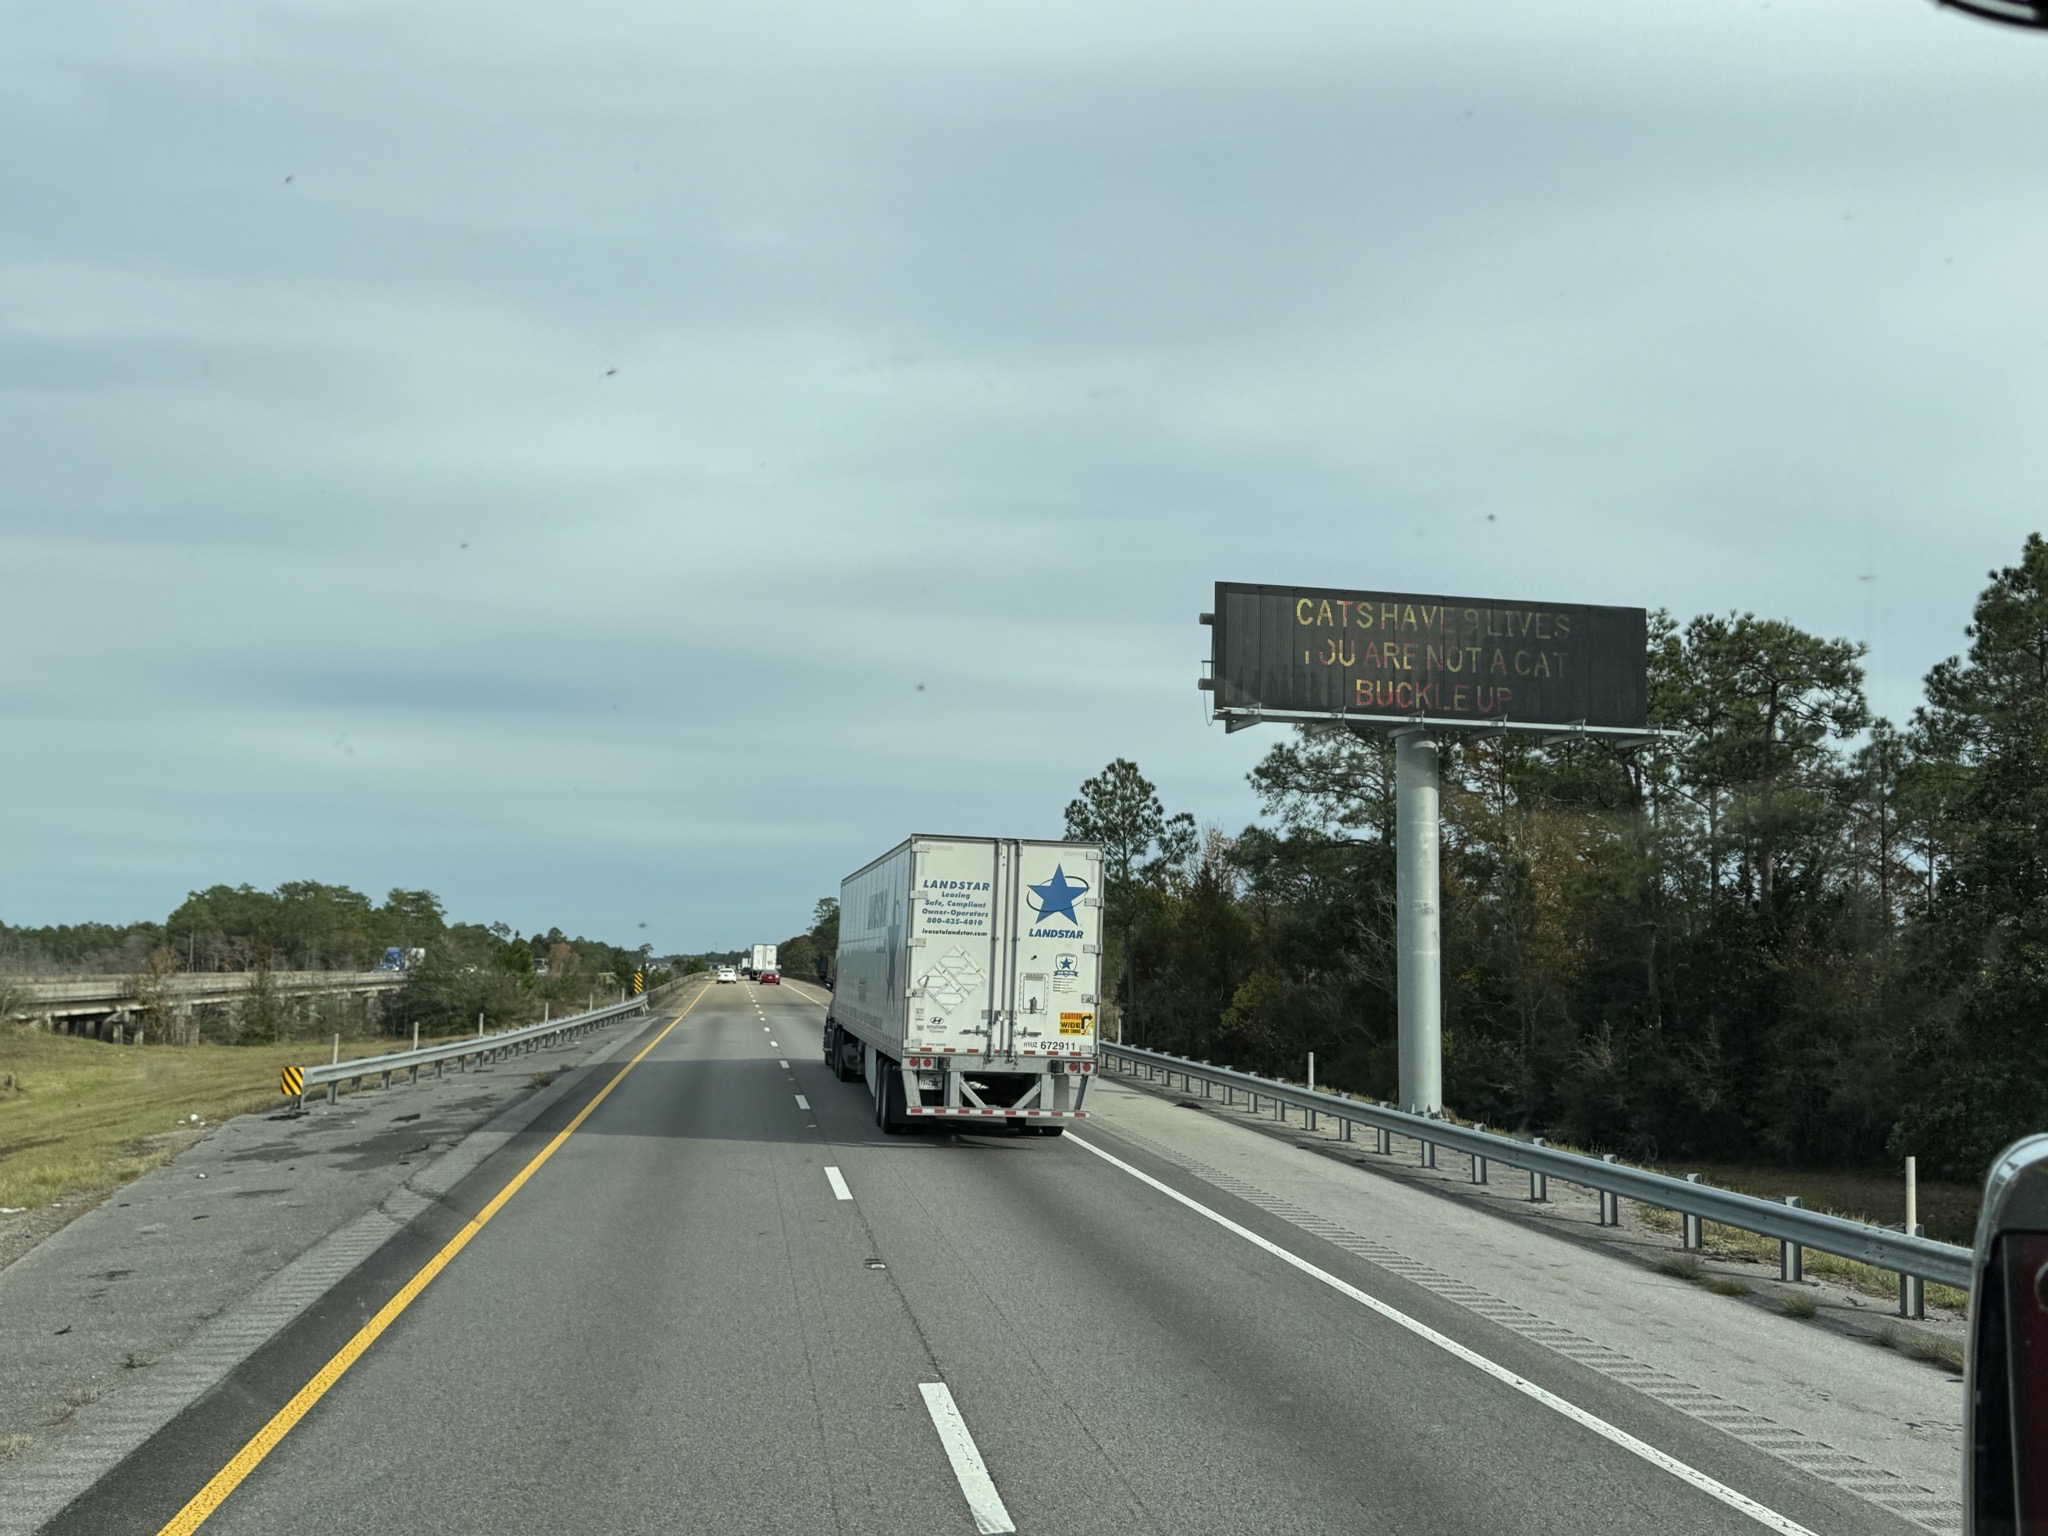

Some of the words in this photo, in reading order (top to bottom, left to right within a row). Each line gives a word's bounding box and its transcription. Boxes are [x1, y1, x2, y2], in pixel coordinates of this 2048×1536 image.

[1296, 598, 1374, 629] CATS
[1380, 603, 1455, 633] HAVE
[1463, 608, 1479, 634] 9
[1487, 609, 1570, 640] LIVES
[1303, 638, 1356, 667] OU
[1364, 641, 1419, 670] ARE
[1426, 644, 1482, 674] NOT
[1490, 648, 1507, 675] A
[1514, 650, 1569, 678] CAT
[1356, 678, 1470, 711] BUCKLE
[1477, 686, 1512, 713] UP
[923, 880, 990, 891] LANDSTAR
[941, 891, 971, 900] Leasing
[925, 899, 944, 907] Safe,
[947, 900, 986, 909] Compliant
[922, 908, 989, 918] Owner-Operators
[926, 917, 983, 926] 800-435-4010
[922, 928, 987, 937] leasetolandstar.com
[1028, 928, 1084, 939] LANDSTAR
[1060, 1012, 1082, 1020] CAUTION
[1060, 1021, 1081, 1029] WIDE
[1040, 1040, 1076, 1051] 672911
